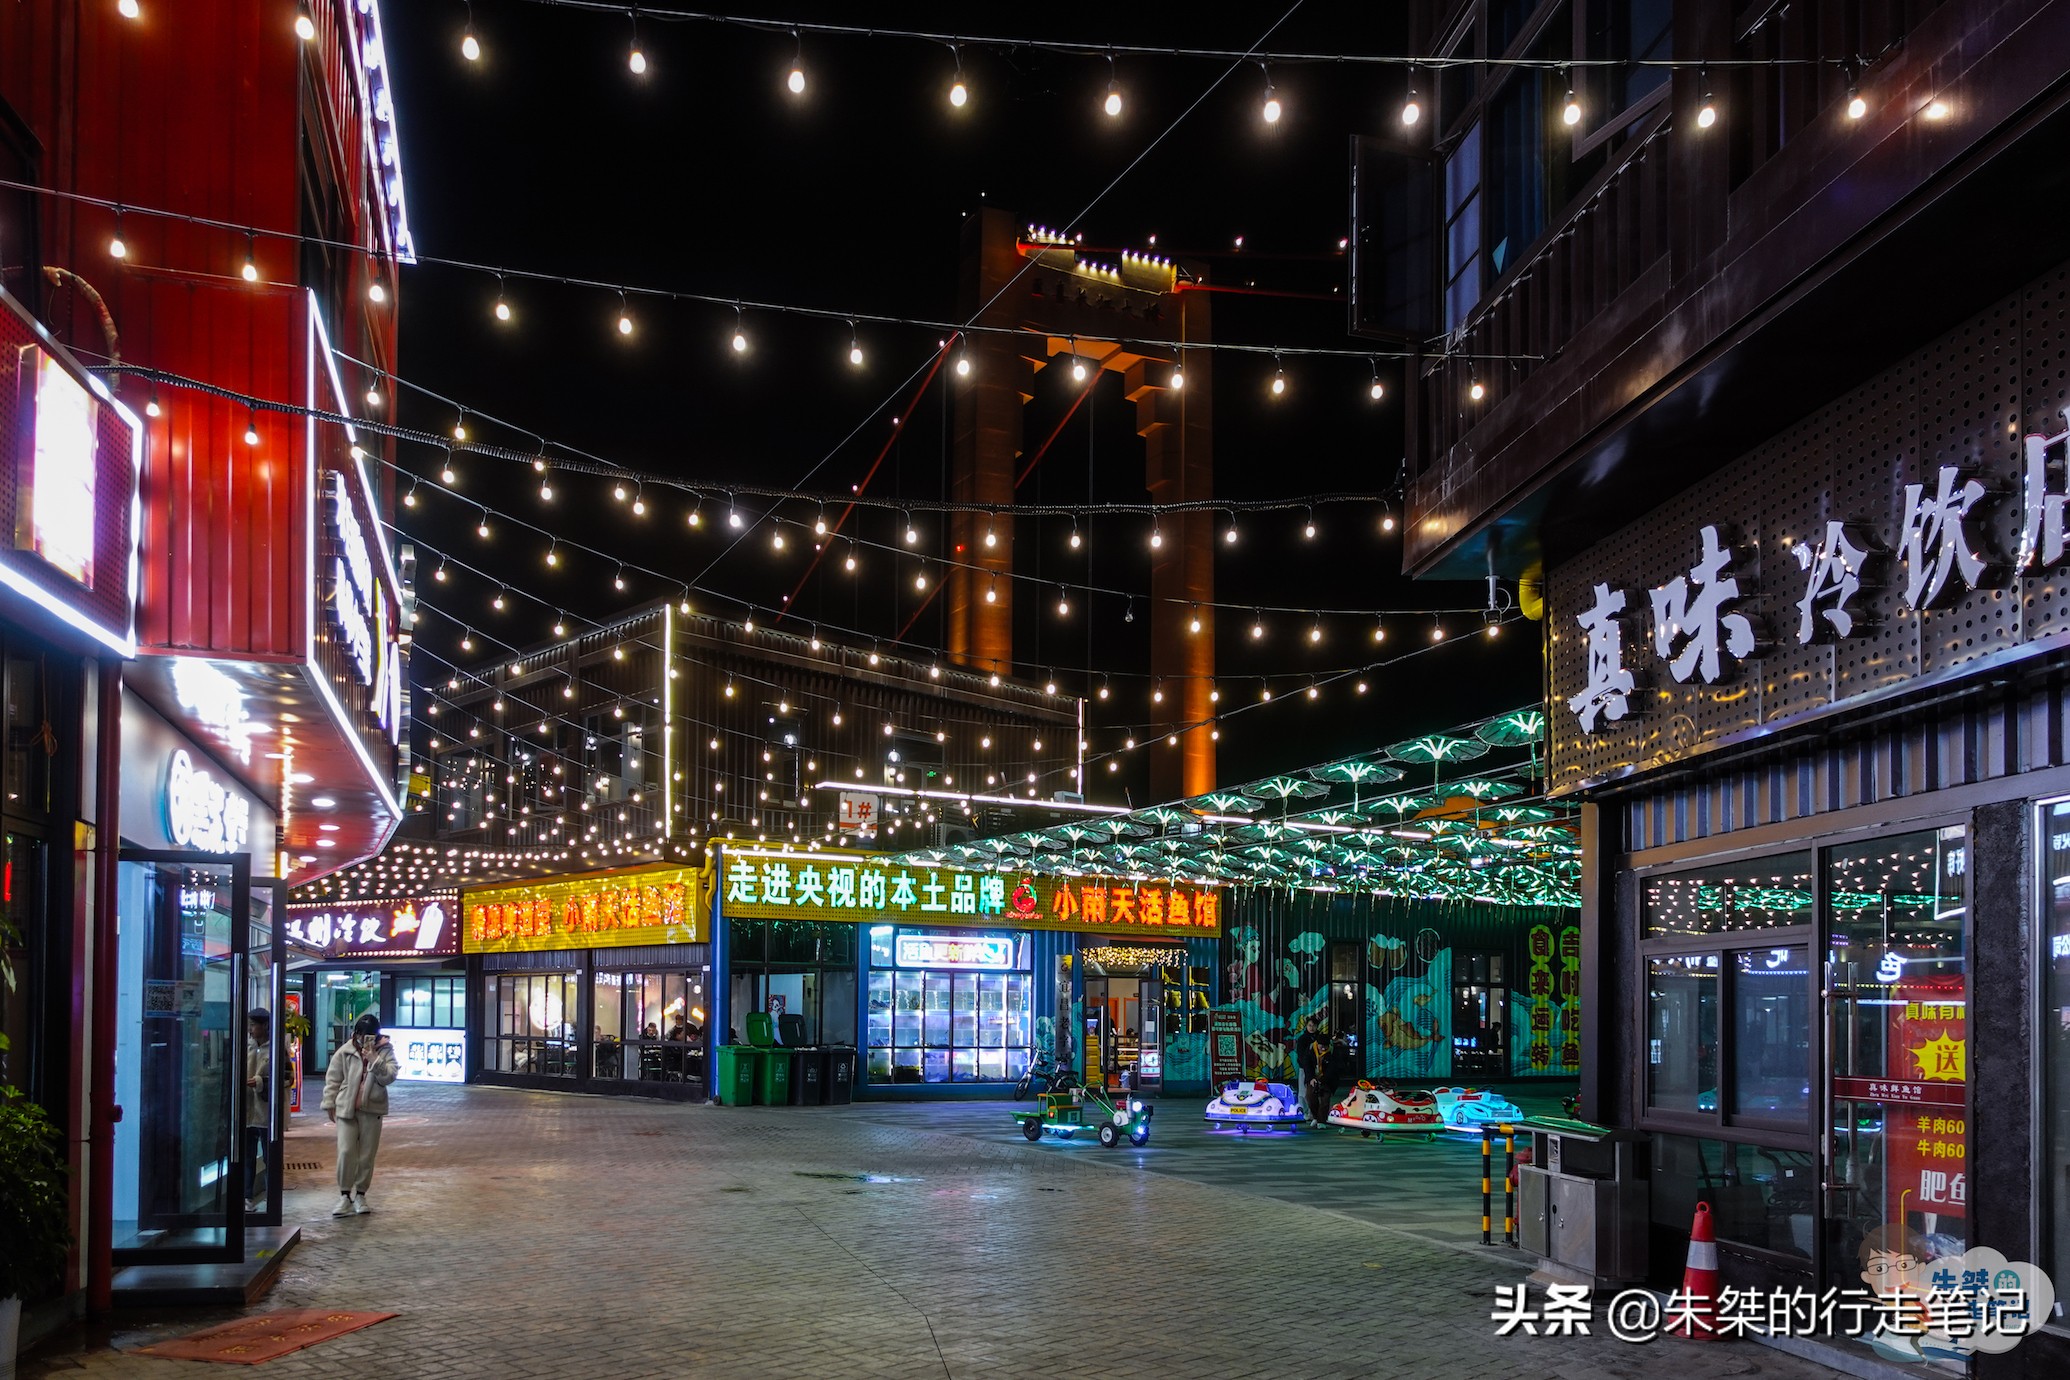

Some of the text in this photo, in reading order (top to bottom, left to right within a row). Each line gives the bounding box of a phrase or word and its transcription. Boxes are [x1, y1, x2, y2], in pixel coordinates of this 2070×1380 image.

[727, 861, 1006, 914] 走进央视的本土品牌
[1052, 883, 1218, 928] 小雨天活鱼馆
[1935, 1044, 1960, 1074] 送
[1868, 1082, 1922, 1095] 真味鲜鱼馆
[1916, 1115, 1966, 1135] 羊肉60
[1916, 1138, 1966, 1159] 牛肉60
